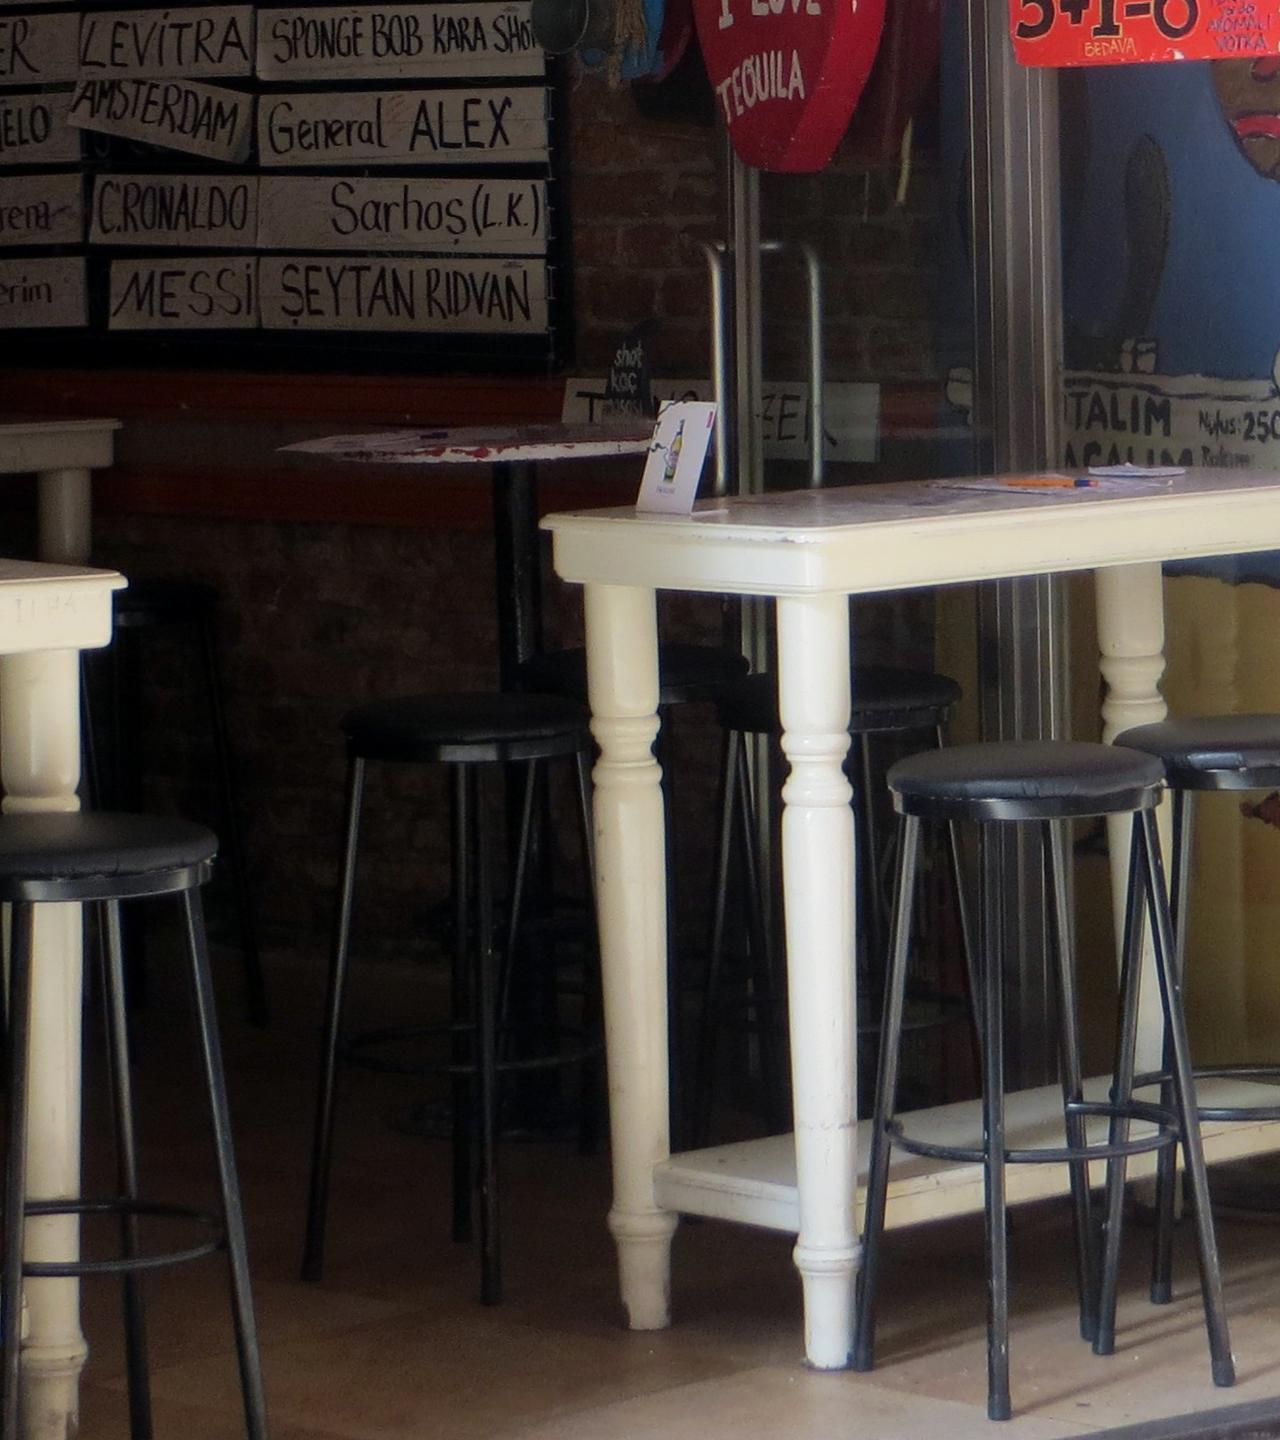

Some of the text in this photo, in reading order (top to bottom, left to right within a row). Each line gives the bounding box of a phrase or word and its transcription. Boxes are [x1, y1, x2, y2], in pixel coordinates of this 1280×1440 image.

[79, 12, 248, 67] LEVİTRA
[272, 12, 487, 63] SPONGE BOB KARA
[1084, 37, 1138, 58] BEDAVA
[70, 79, 239, 147] AMSTERDAM
[716, 48, 806, 124] TEQUILA
[269, 96, 513, 155] General ALEX
[331, 181, 467, 245] Sarhoş
[112, 264, 253, 319] MESSİ
[281, 263, 532, 327] ŞEYTAN RIDVAN
